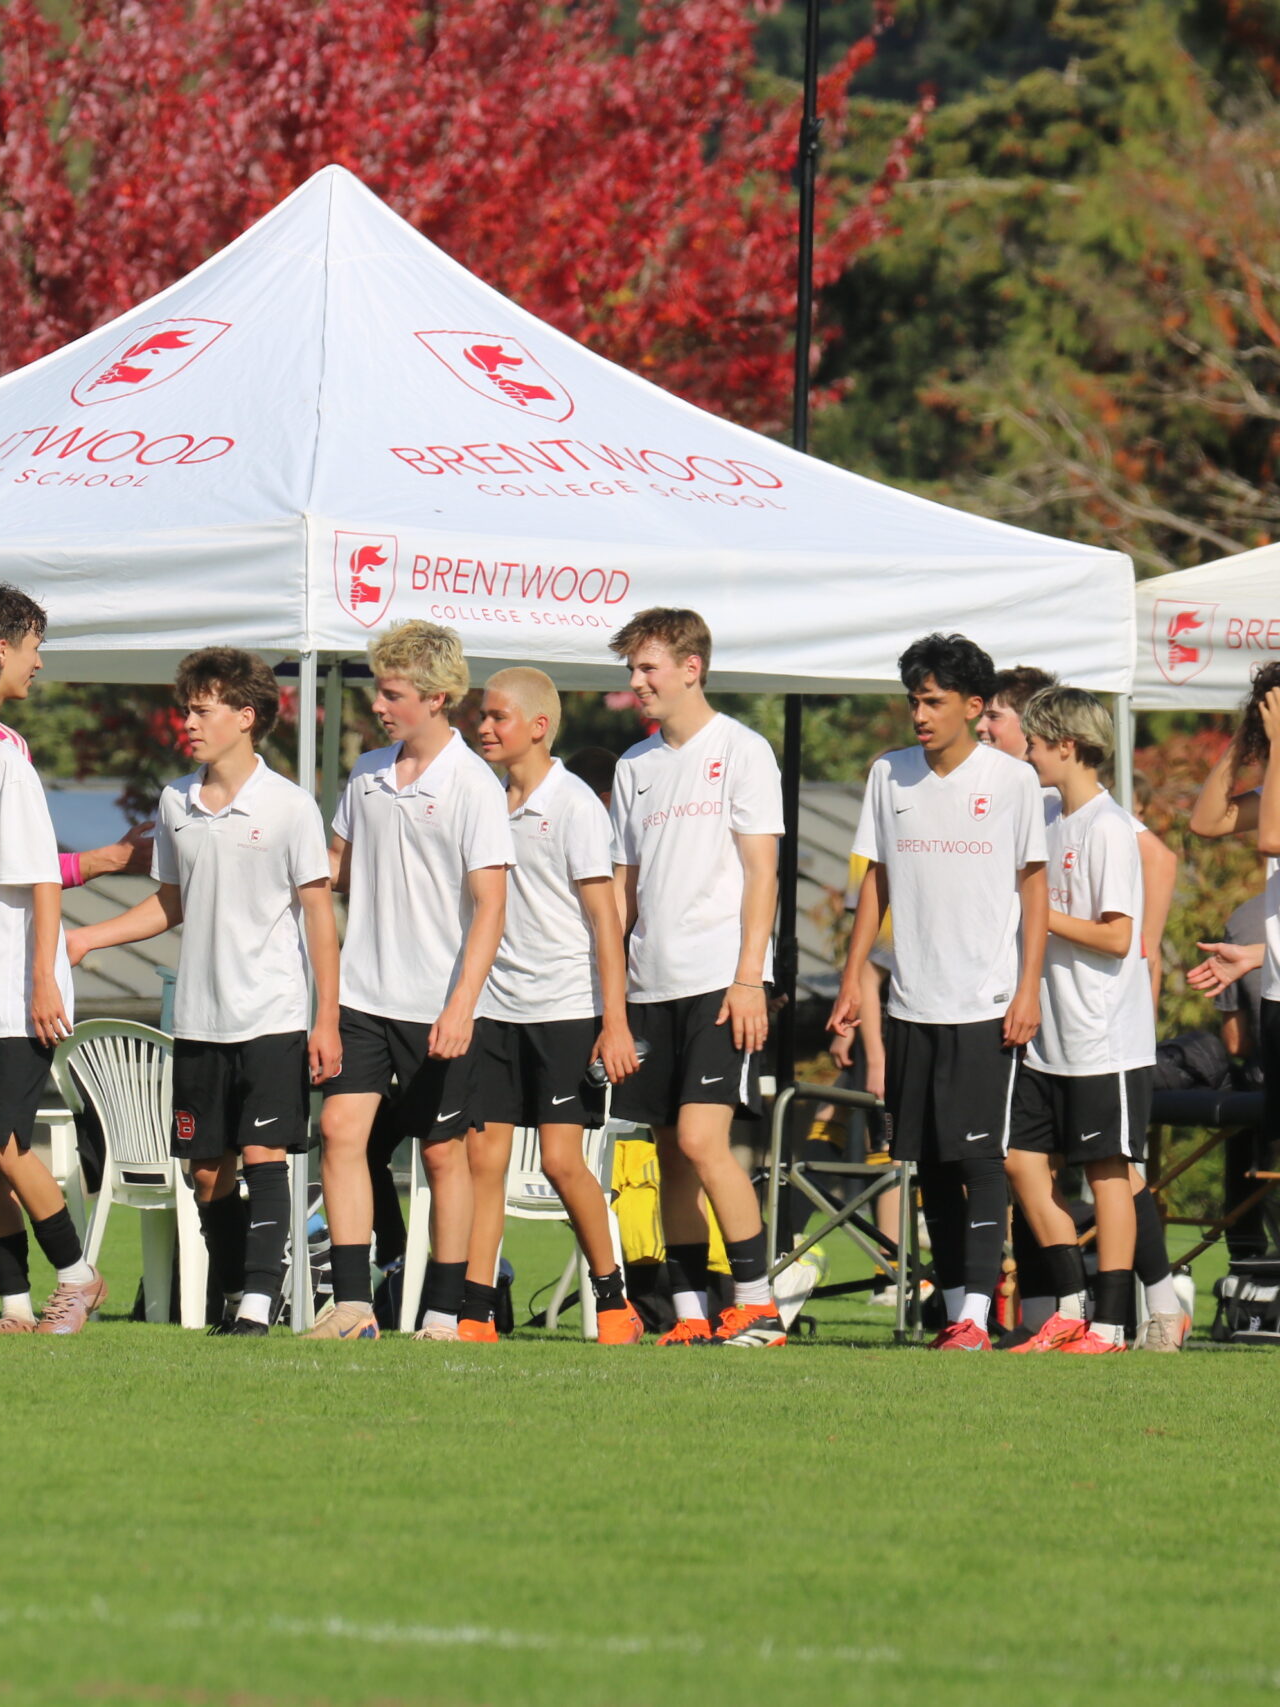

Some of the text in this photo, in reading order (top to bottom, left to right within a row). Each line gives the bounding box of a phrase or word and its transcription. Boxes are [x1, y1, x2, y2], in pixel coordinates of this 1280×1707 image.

[14, 468, 150, 488] SCHOOL
[388, 439, 784, 489] BRENTWOOD
[477, 480, 787, 510] COLLEGE SCHOOL
[411, 554, 631, 605] BRENTWOOD
[431, 604, 614, 629] COLLEGE SCHOOL
[642, 800, 724, 832] BRENWOOD
[896, 839, 993, 855] BRENTWOOD
[174, 1110, 196, 1140] B
